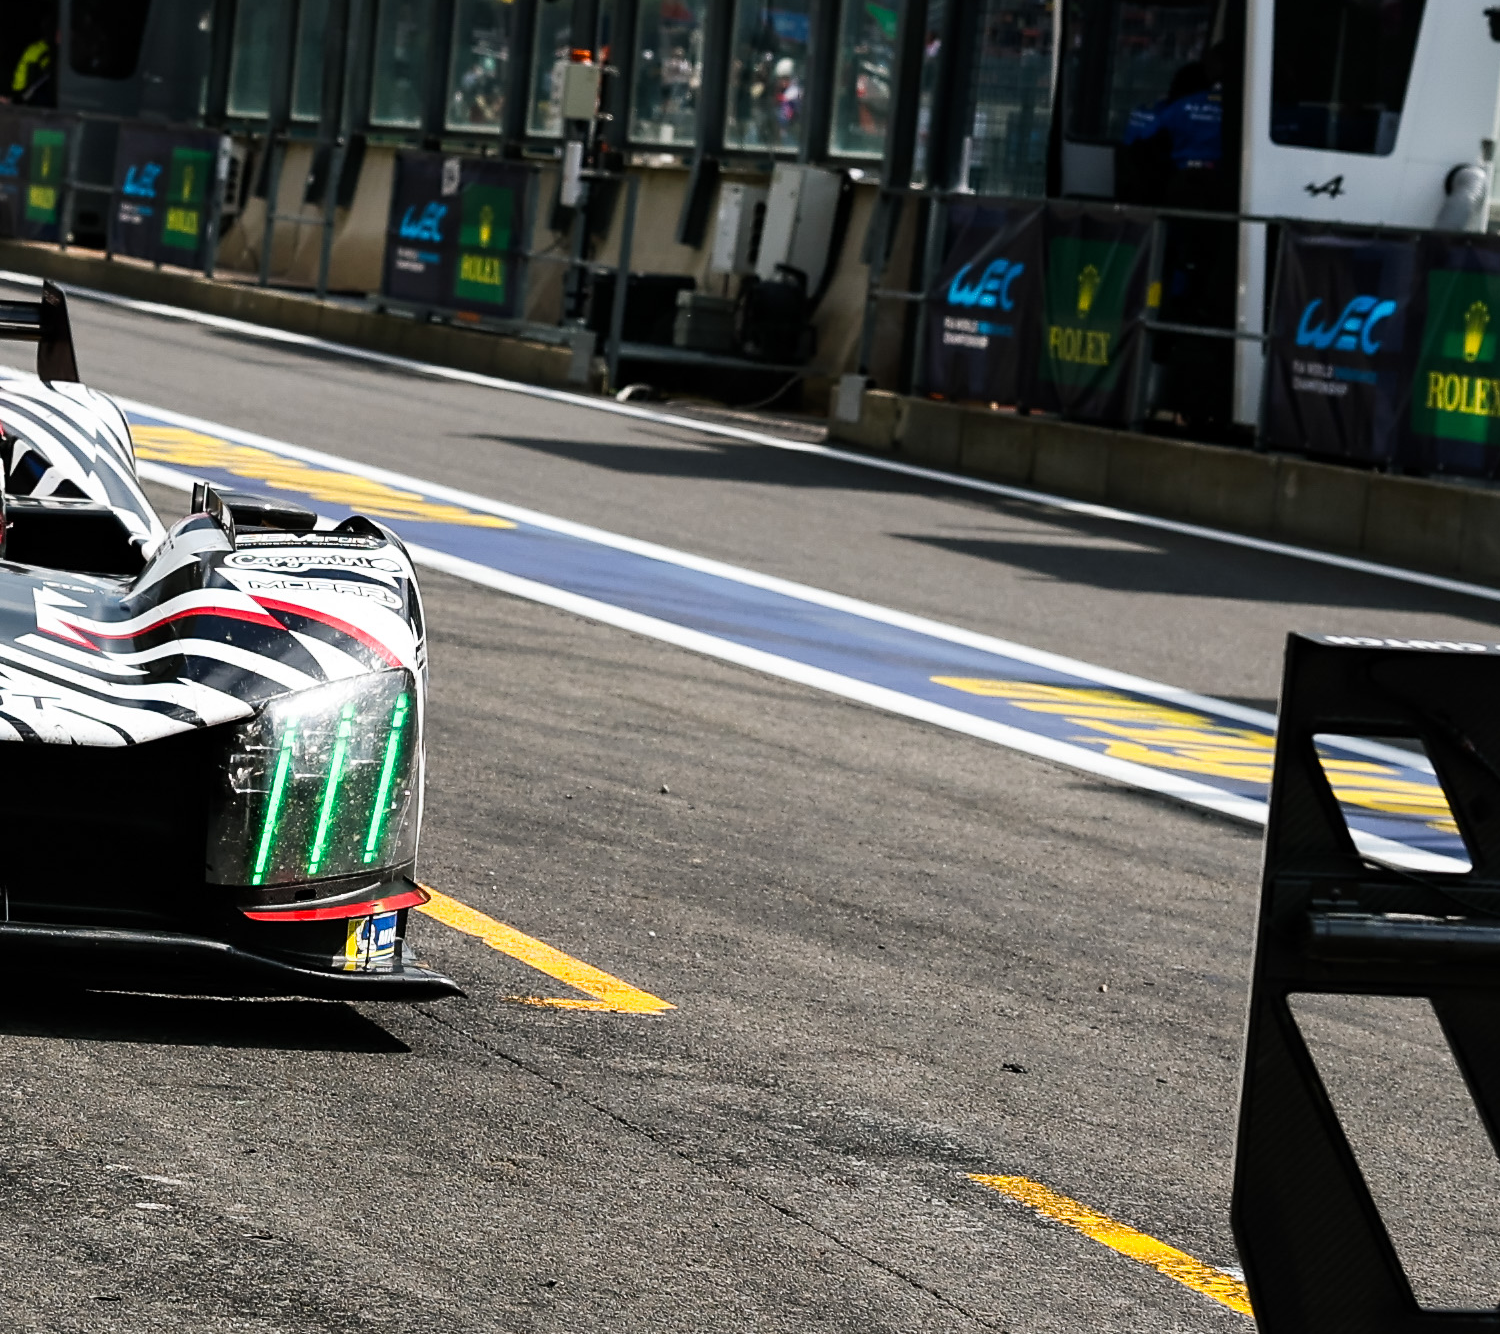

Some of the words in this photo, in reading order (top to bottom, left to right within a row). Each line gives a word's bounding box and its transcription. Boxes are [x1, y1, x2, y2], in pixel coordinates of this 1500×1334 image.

[947, 257, 1025, 312] WEC
[1295, 294, 1398, 356] WEC
[235, 554, 372, 567] Capgemini
[249, 579, 390, 604] MOPAR
